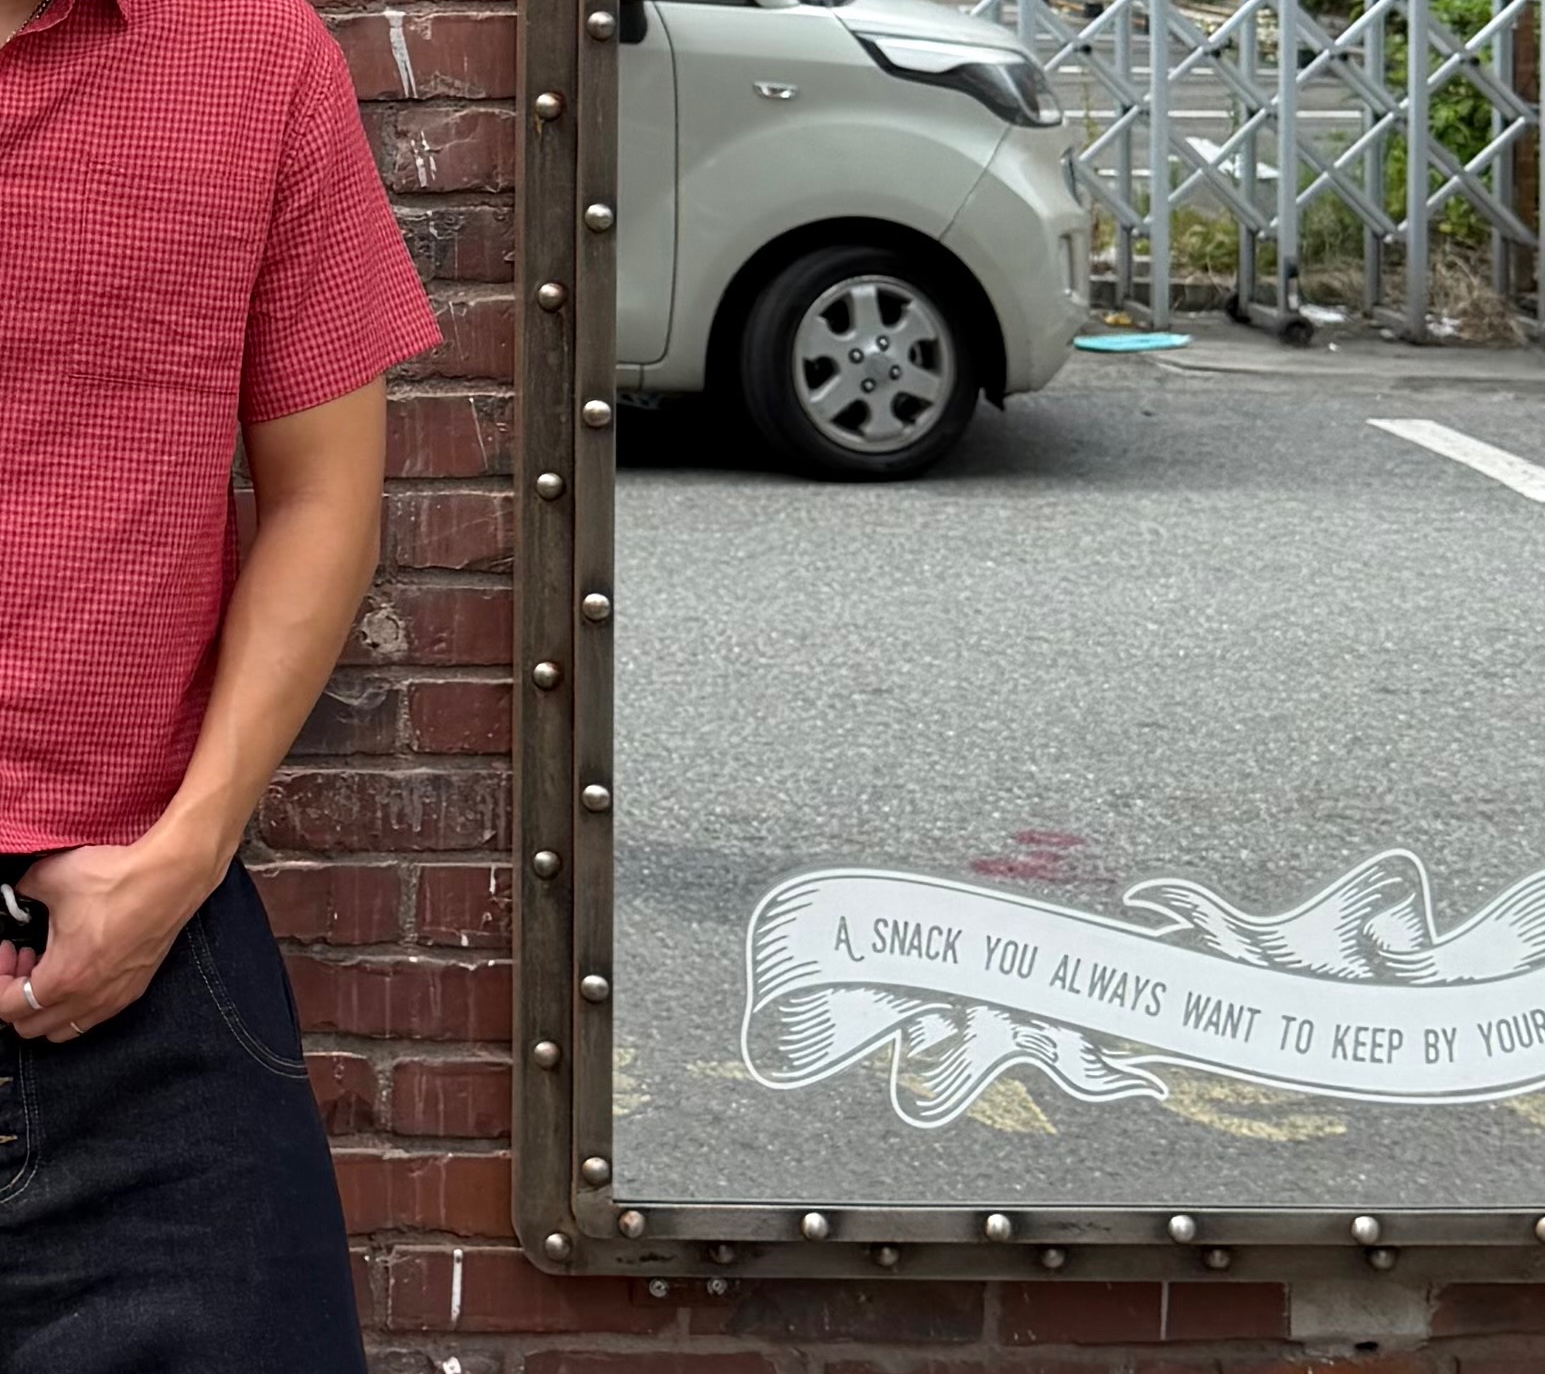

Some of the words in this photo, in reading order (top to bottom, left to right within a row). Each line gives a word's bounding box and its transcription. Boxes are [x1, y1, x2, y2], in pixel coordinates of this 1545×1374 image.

[835, 916, 865, 963] A
[872, 917, 963, 964] SNACK
[985, 935, 1039, 979] YOU
[1049, 955, 1167, 1017] ALWAYS
[1182, 991, 1262, 1043] WANT
[1280, 1014, 1314, 1055] TO
[1331, 1024, 1404, 1064] KEEP
[1424, 1027, 1457, 1064] BY
[1477, 1008, 1545, 1057] YOUR
